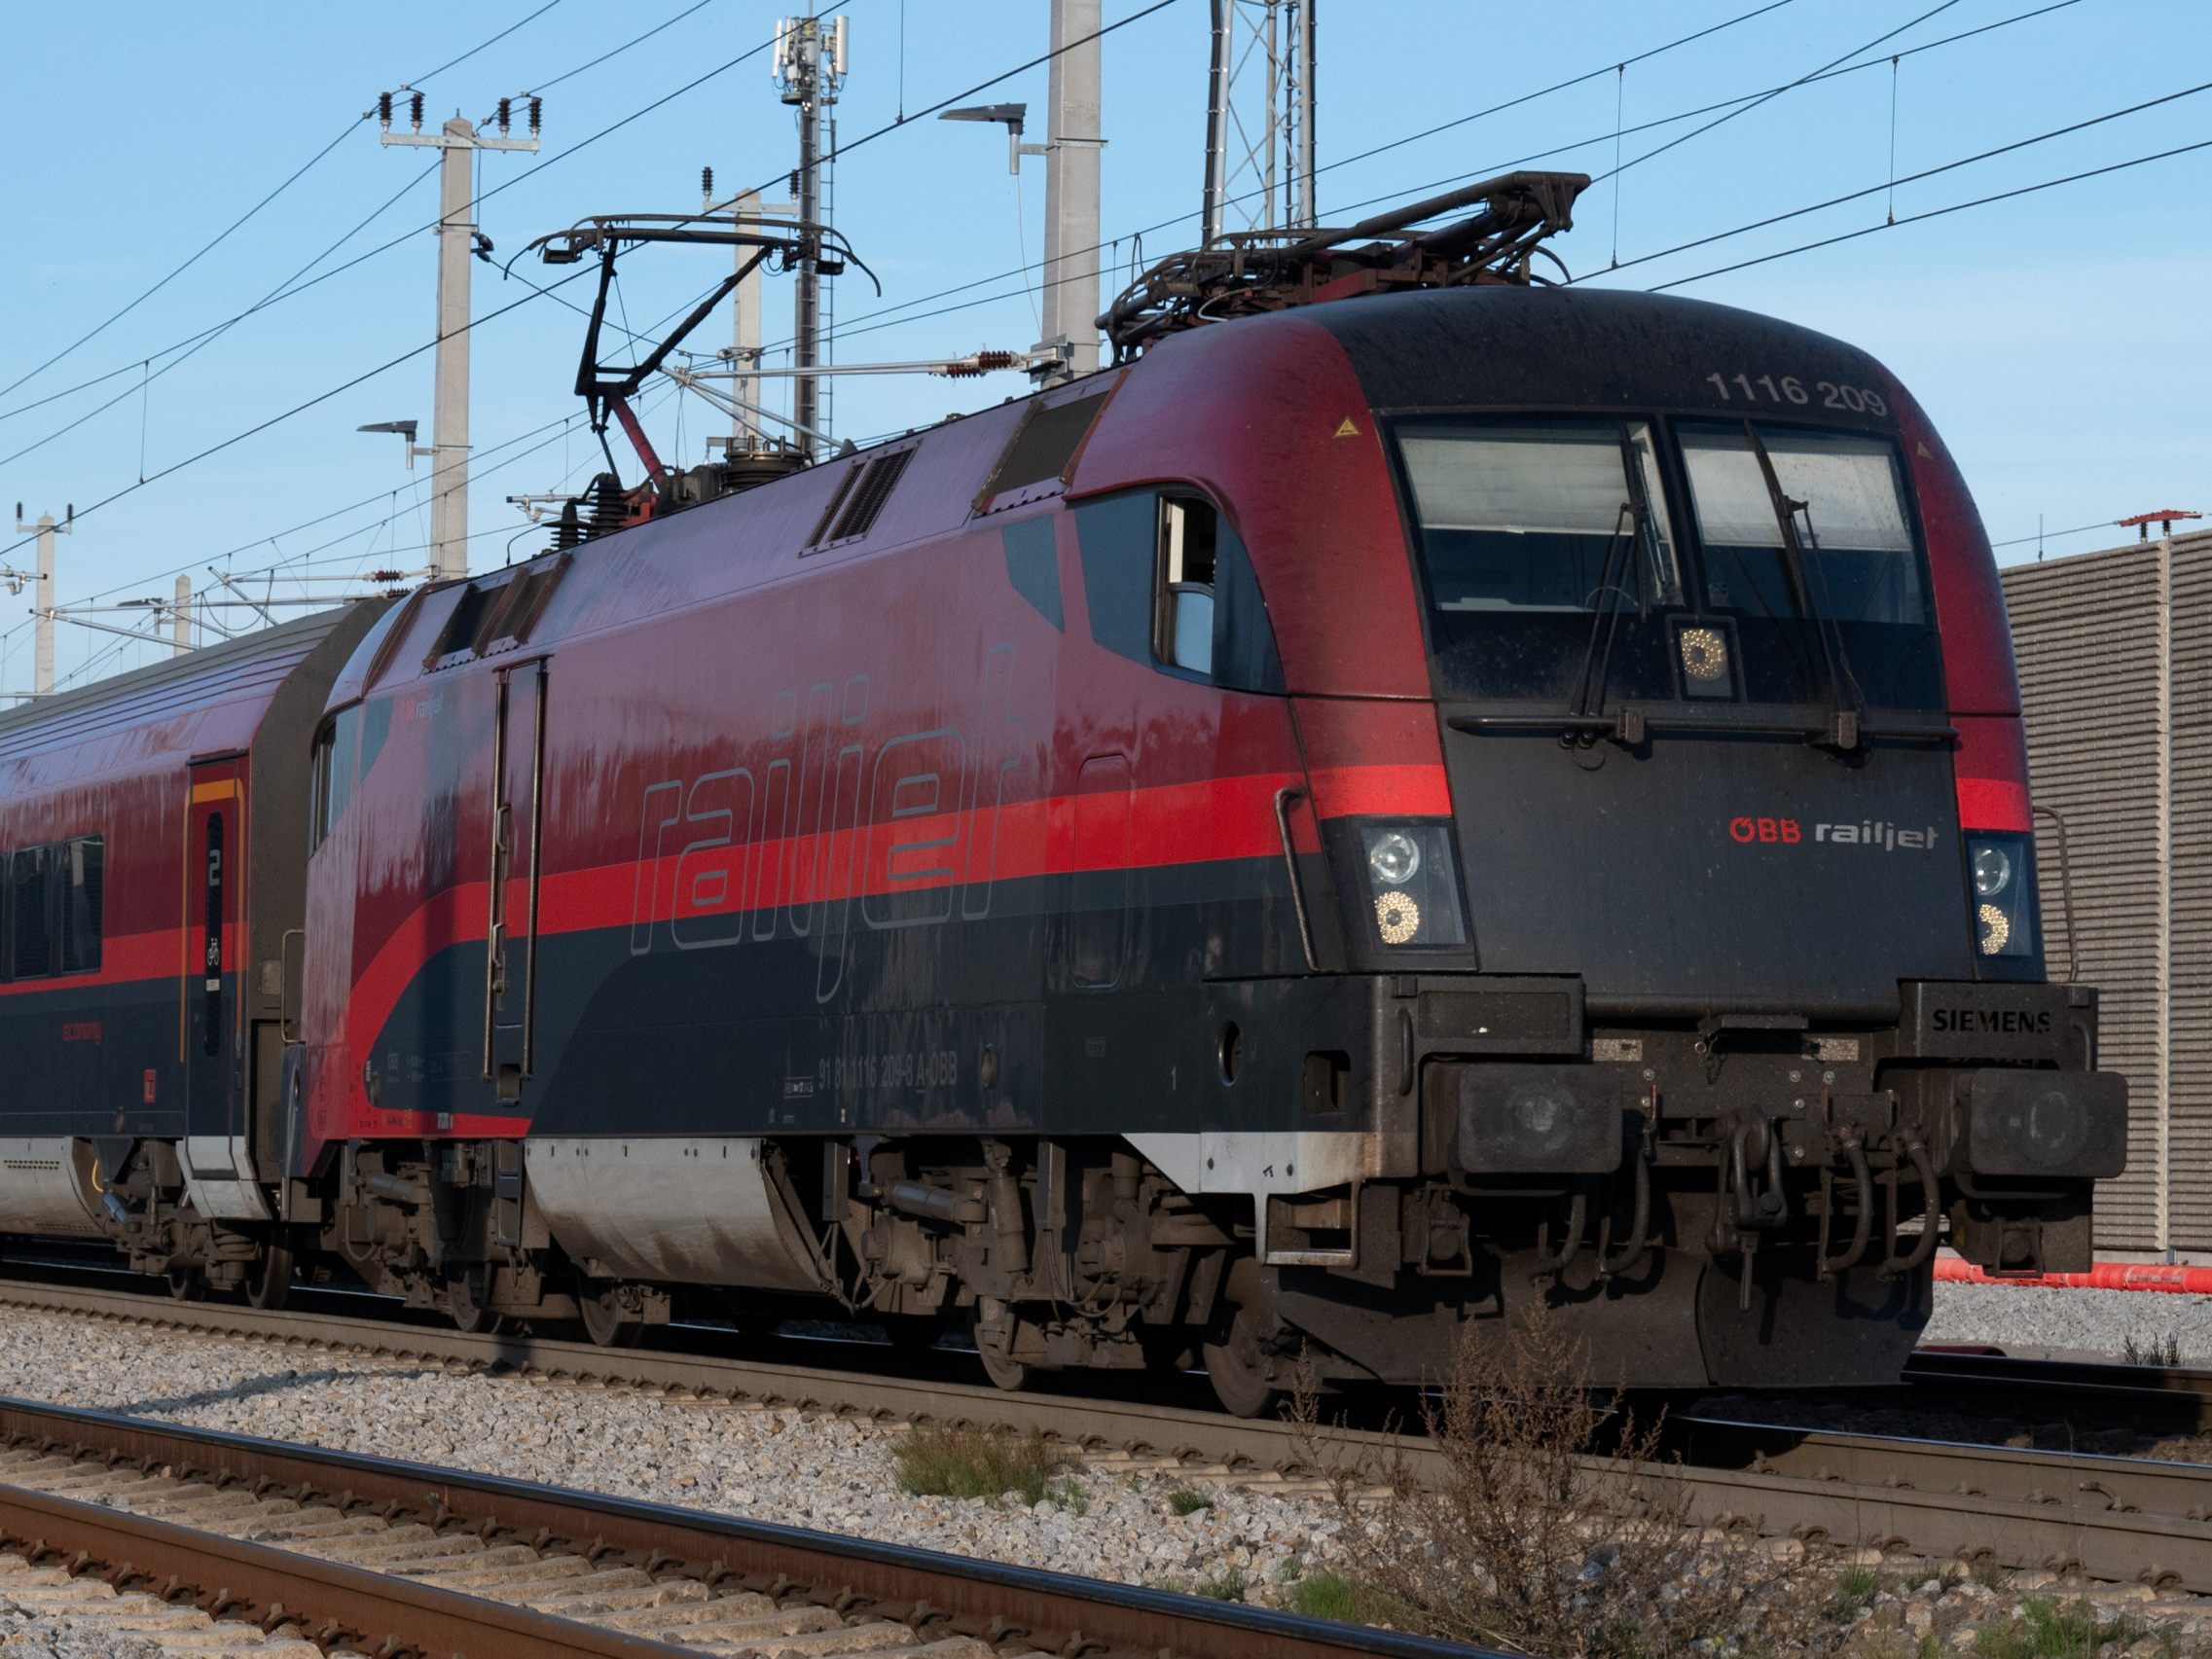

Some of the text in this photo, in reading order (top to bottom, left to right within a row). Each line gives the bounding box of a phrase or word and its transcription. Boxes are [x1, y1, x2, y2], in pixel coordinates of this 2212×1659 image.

[1707, 372, 1888, 417] 1116 209
[631, 644, 1025, 1004] railjet
[1729, 816, 1939, 851] ÖBB railjet
[209, 848, 221, 886] 2
[1932, 1008, 2051, 1034] SIEMENS
[818, 1058, 831, 1091] 91
